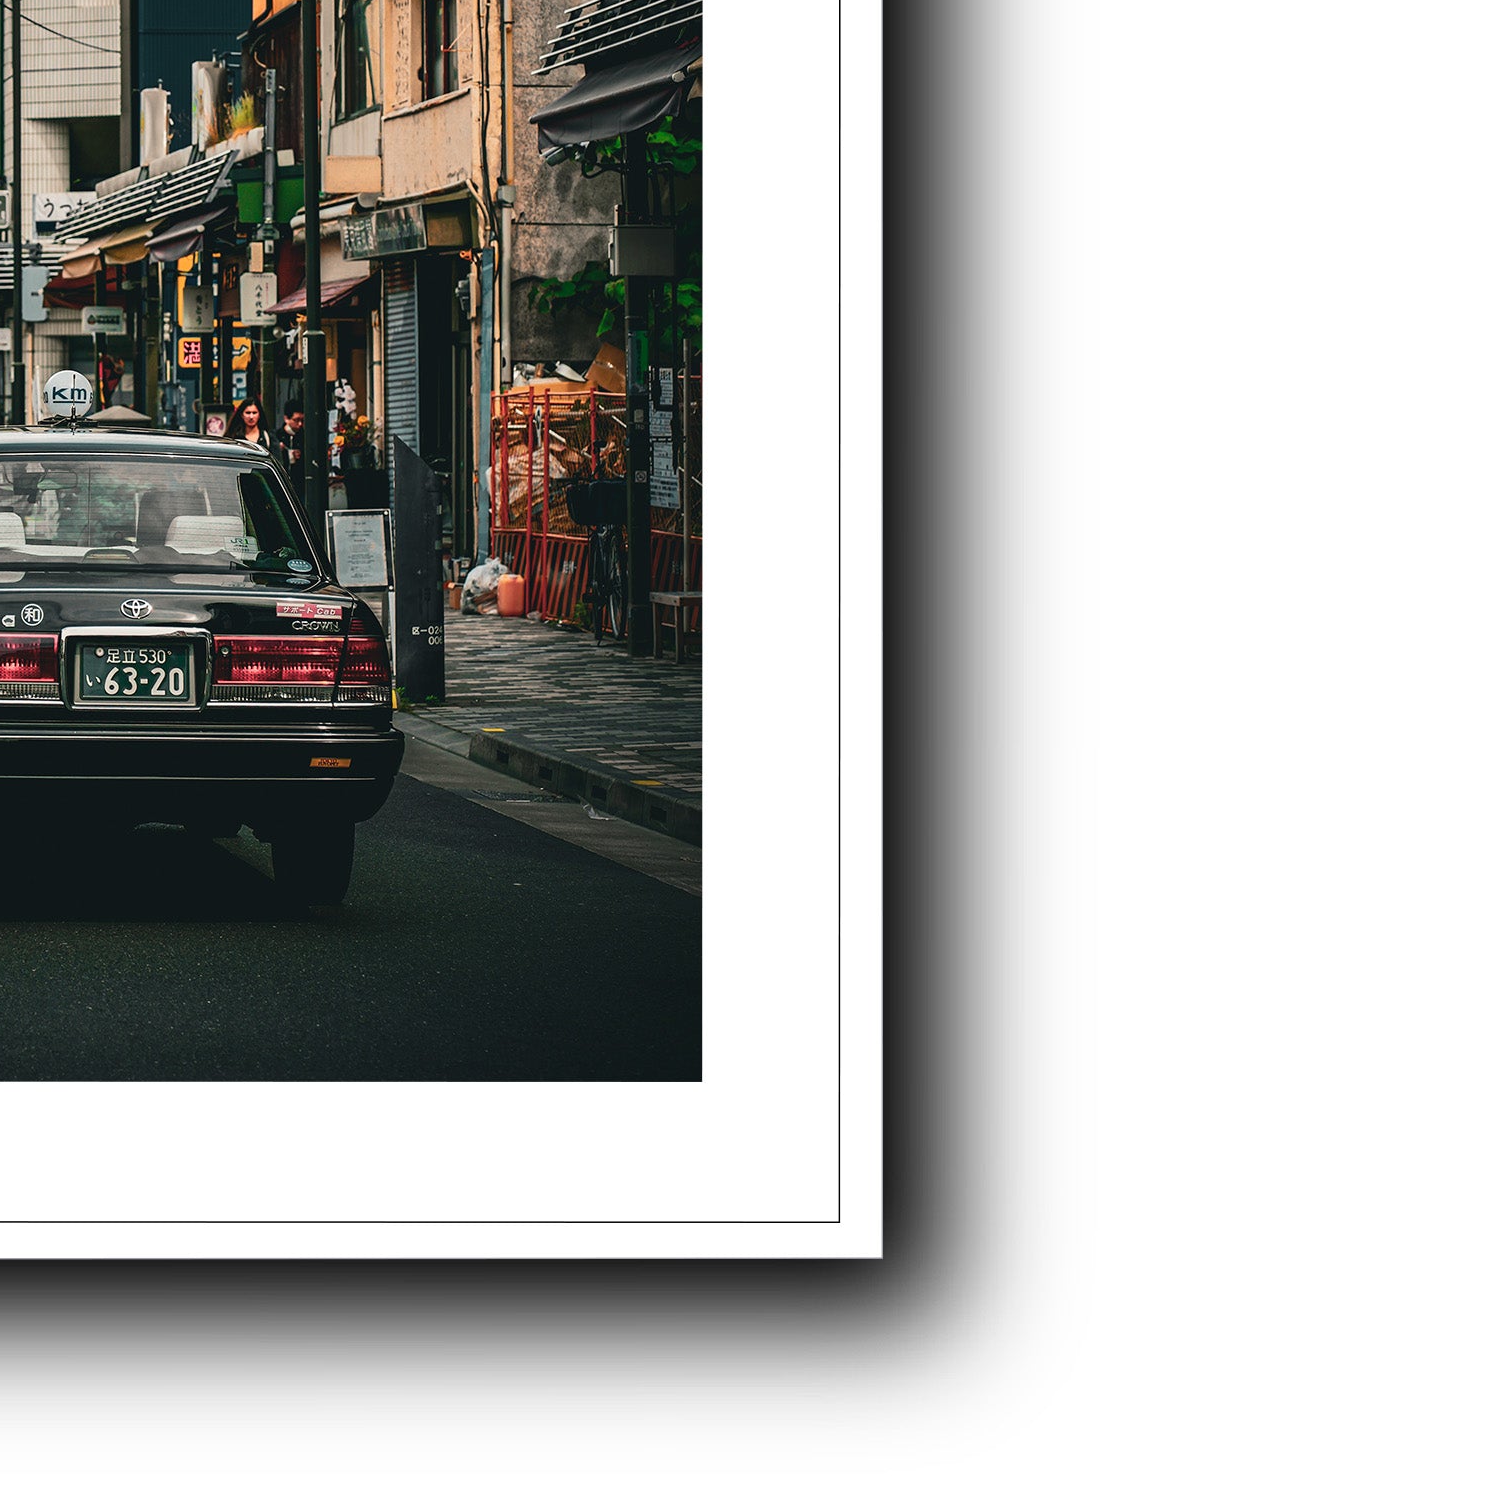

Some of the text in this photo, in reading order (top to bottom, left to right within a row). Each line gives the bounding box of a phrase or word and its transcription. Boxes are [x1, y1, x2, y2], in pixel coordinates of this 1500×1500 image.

[23, 605, 42, 624] 和
[283, 606, 336, 616] サポート Cab
[291, 620, 341, 632] CROWN
[106, 648, 137, 664] 足立
[85, 666, 185, 696] い 63-20
